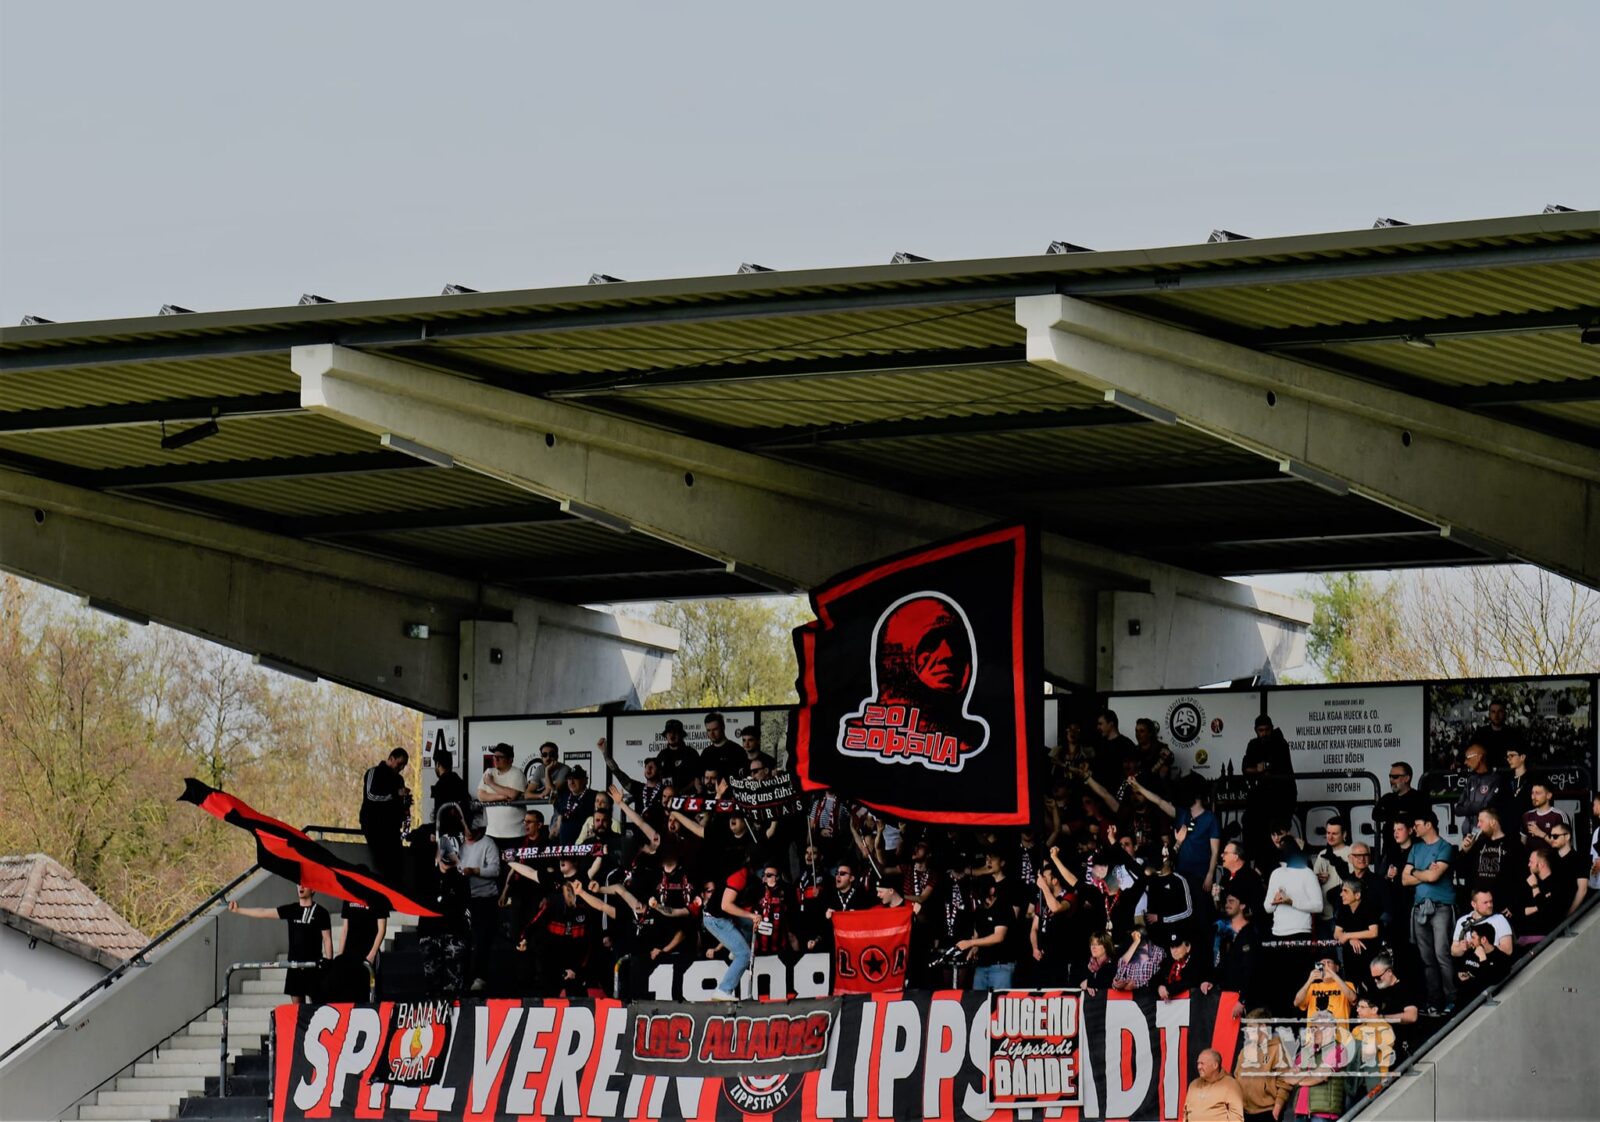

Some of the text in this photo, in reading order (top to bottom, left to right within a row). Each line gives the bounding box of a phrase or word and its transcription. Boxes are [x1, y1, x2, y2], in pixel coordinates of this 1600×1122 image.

[1308, 711, 1326, 721] HELLA
[1343, 710, 1362, 720] HUECK
[1364, 710, 1369, 719] &
[1369, 710, 1379, 719] CO.
[1296, 724, 1393, 736] WILHELM KNEPPER GMBH & CO. KG
[1288, 737, 1401, 751] FRANZ BRACHT KRAN-VERMIETUNG GMBH
[1323, 752, 1364, 764] LIEBELT BÖDEN
[739, 791, 757, 805] Weg
[757, 791, 772, 802] uns
[774, 786, 796, 799] führ
[1326, 782, 1361, 793] HBPO GMBH
[991, 996, 1077, 1036] JUGEND
[633, 1010, 832, 1064] LOS ALIADOS
[994, 1038, 1073, 1060] Lippstadt
[388, 1056, 436, 1082] SQUAD
[994, 1058, 1075, 1096] BANDE
[729, 1084, 789, 1111] LIPPSTADT
